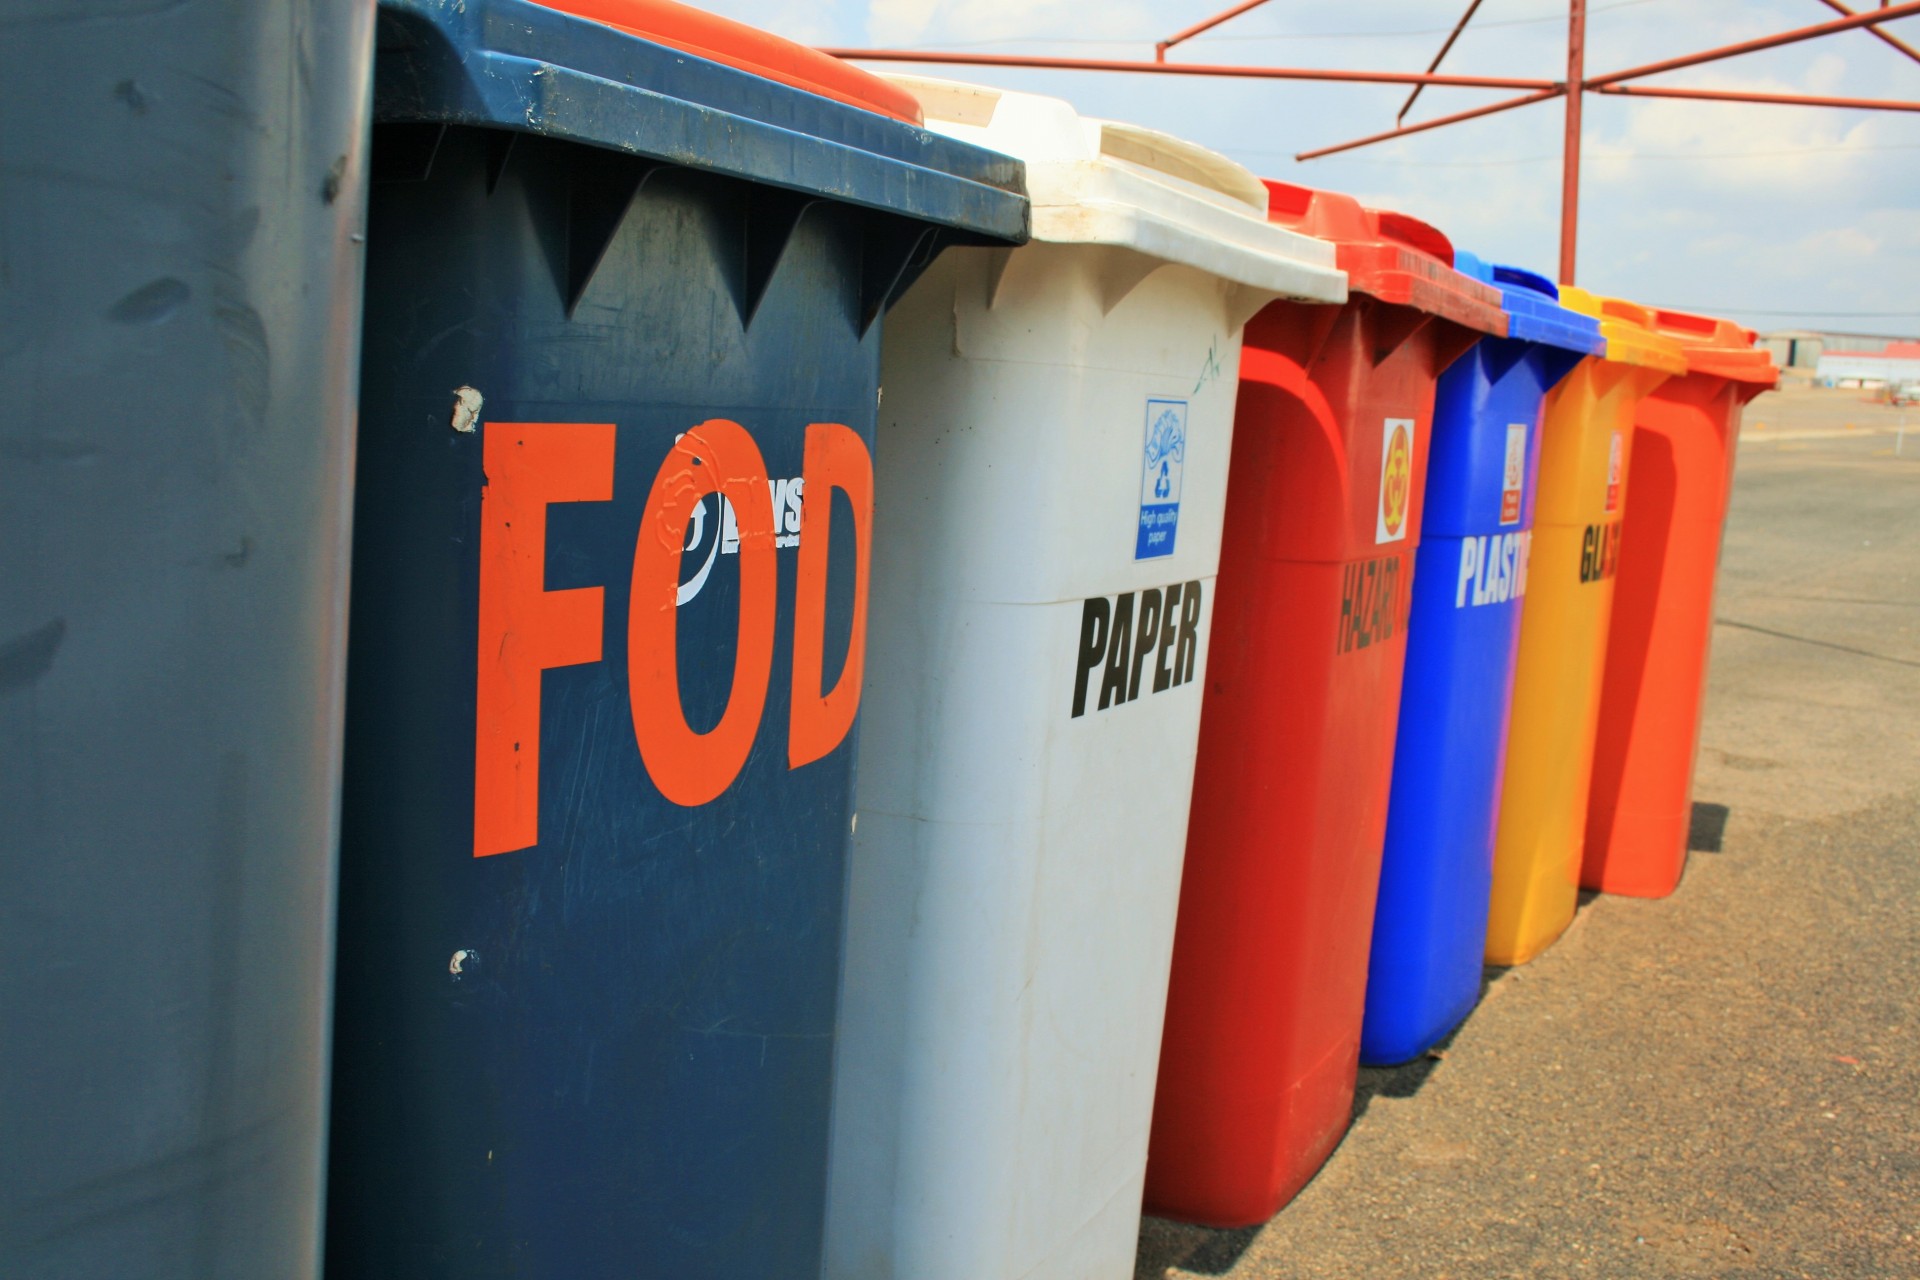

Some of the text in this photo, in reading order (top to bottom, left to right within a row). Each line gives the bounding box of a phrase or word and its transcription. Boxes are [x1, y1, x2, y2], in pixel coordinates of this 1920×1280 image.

[1140, 508, 1178, 529] High quality
[1147, 531, 1167, 547] paper
[473, 418, 874, 858] FOD
[1071, 580, 1202, 719] PAPER
